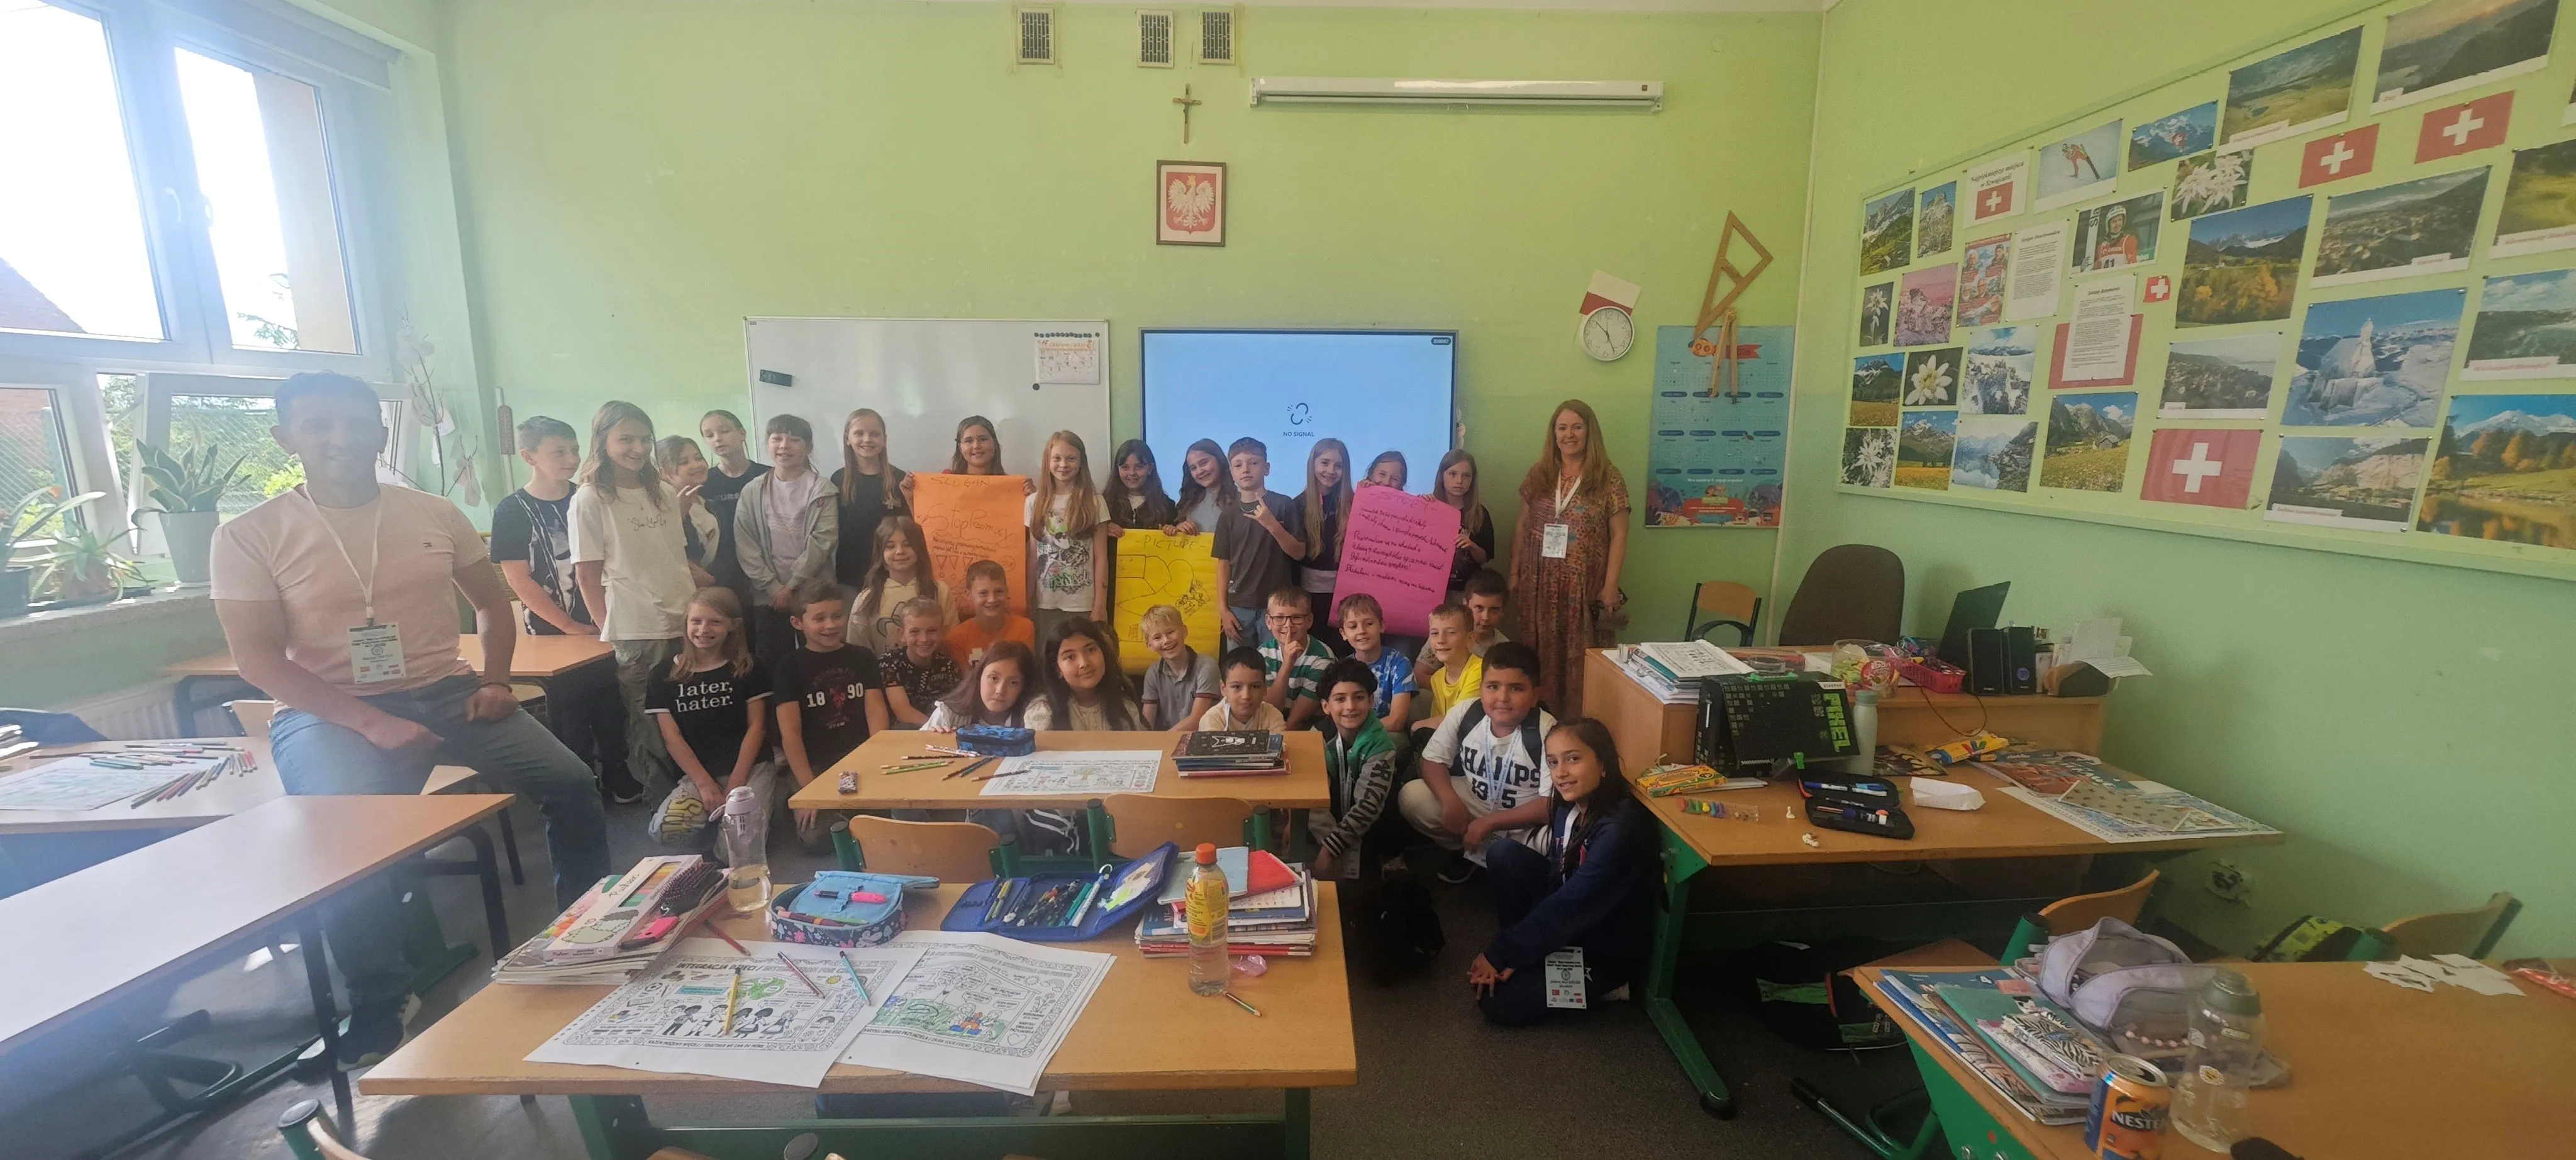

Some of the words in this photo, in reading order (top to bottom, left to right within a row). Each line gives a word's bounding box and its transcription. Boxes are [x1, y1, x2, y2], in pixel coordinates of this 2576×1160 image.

[2104, 259, 2114, 269] 41
[678, 680, 733, 698] later,
[807, 692, 826, 708] 18
[847, 683, 864, 700] 90
[675, 696, 733, 713] hater.
[1336, 759, 1392, 835] ARIZONA
